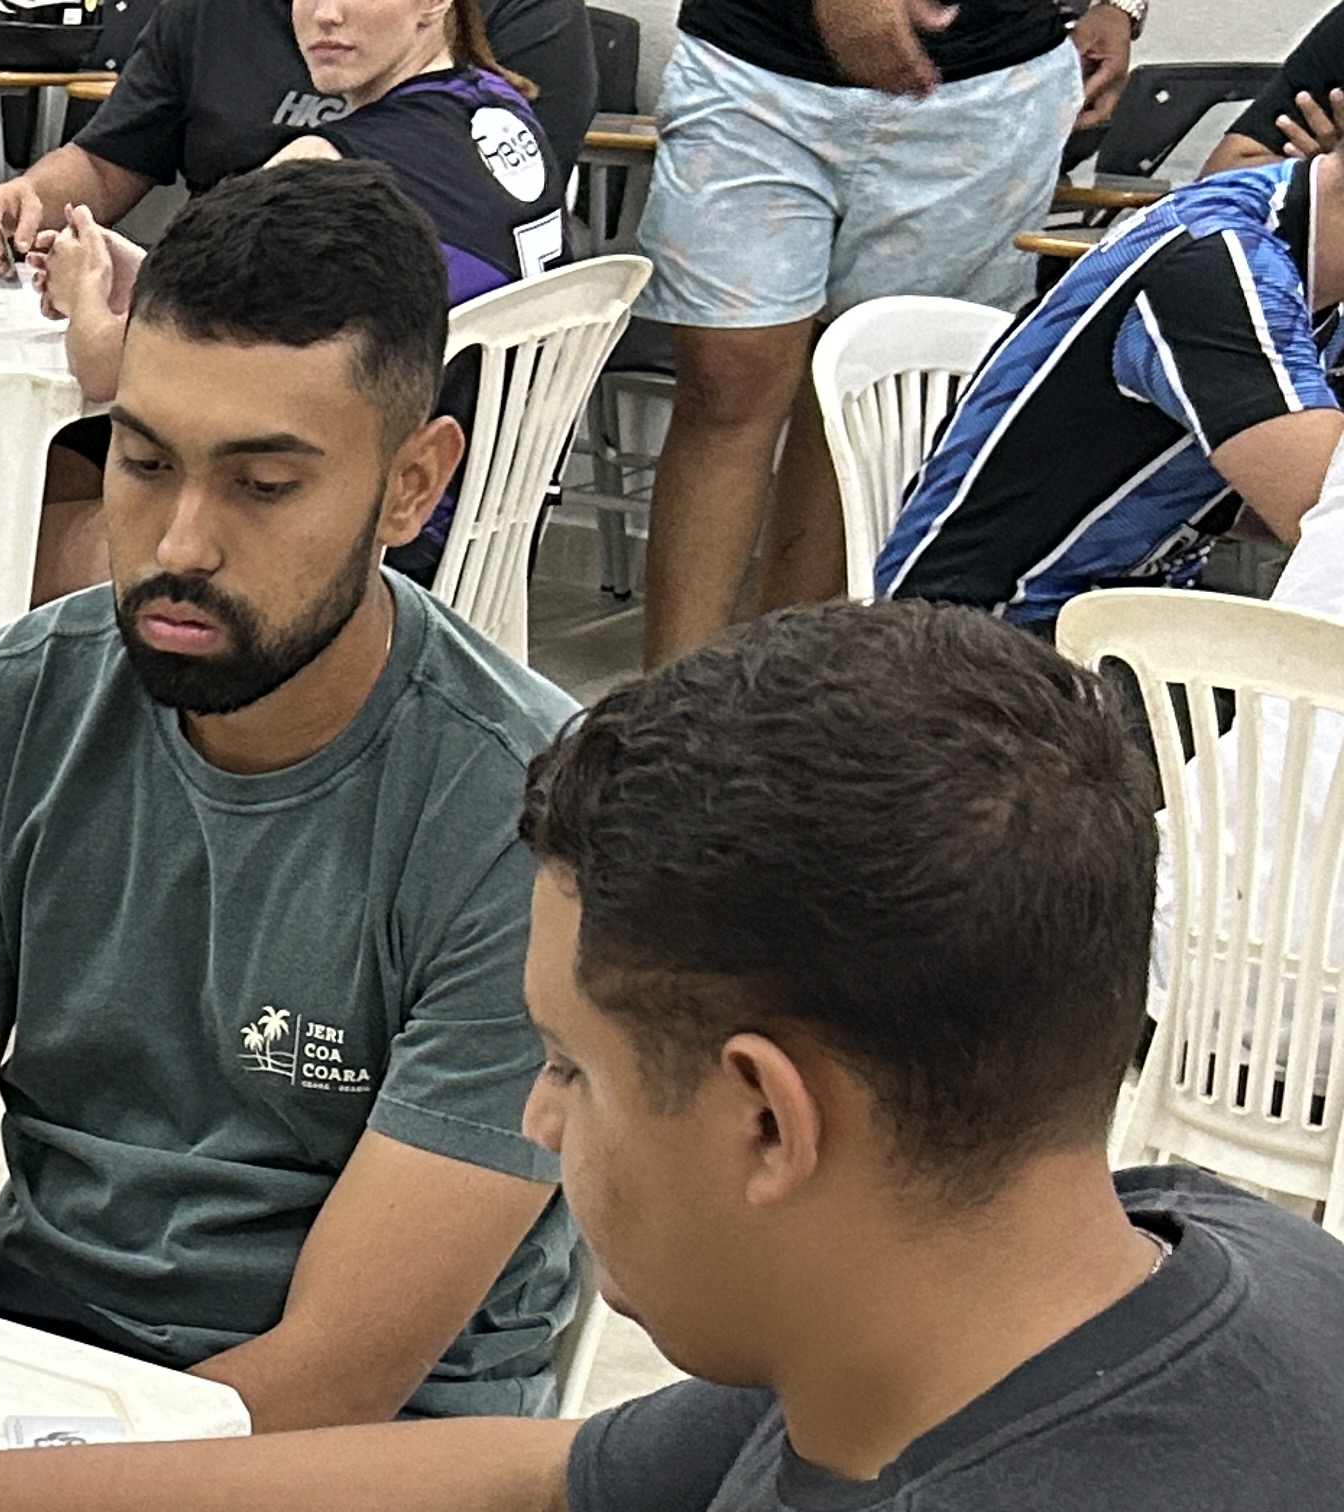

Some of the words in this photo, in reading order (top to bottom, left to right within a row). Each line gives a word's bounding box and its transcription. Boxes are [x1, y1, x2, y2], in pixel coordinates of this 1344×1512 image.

[306, 1022, 344, 1042] JERI
[304, 1043, 342, 1062] COA
[302, 1063, 370, 1083] COARA
